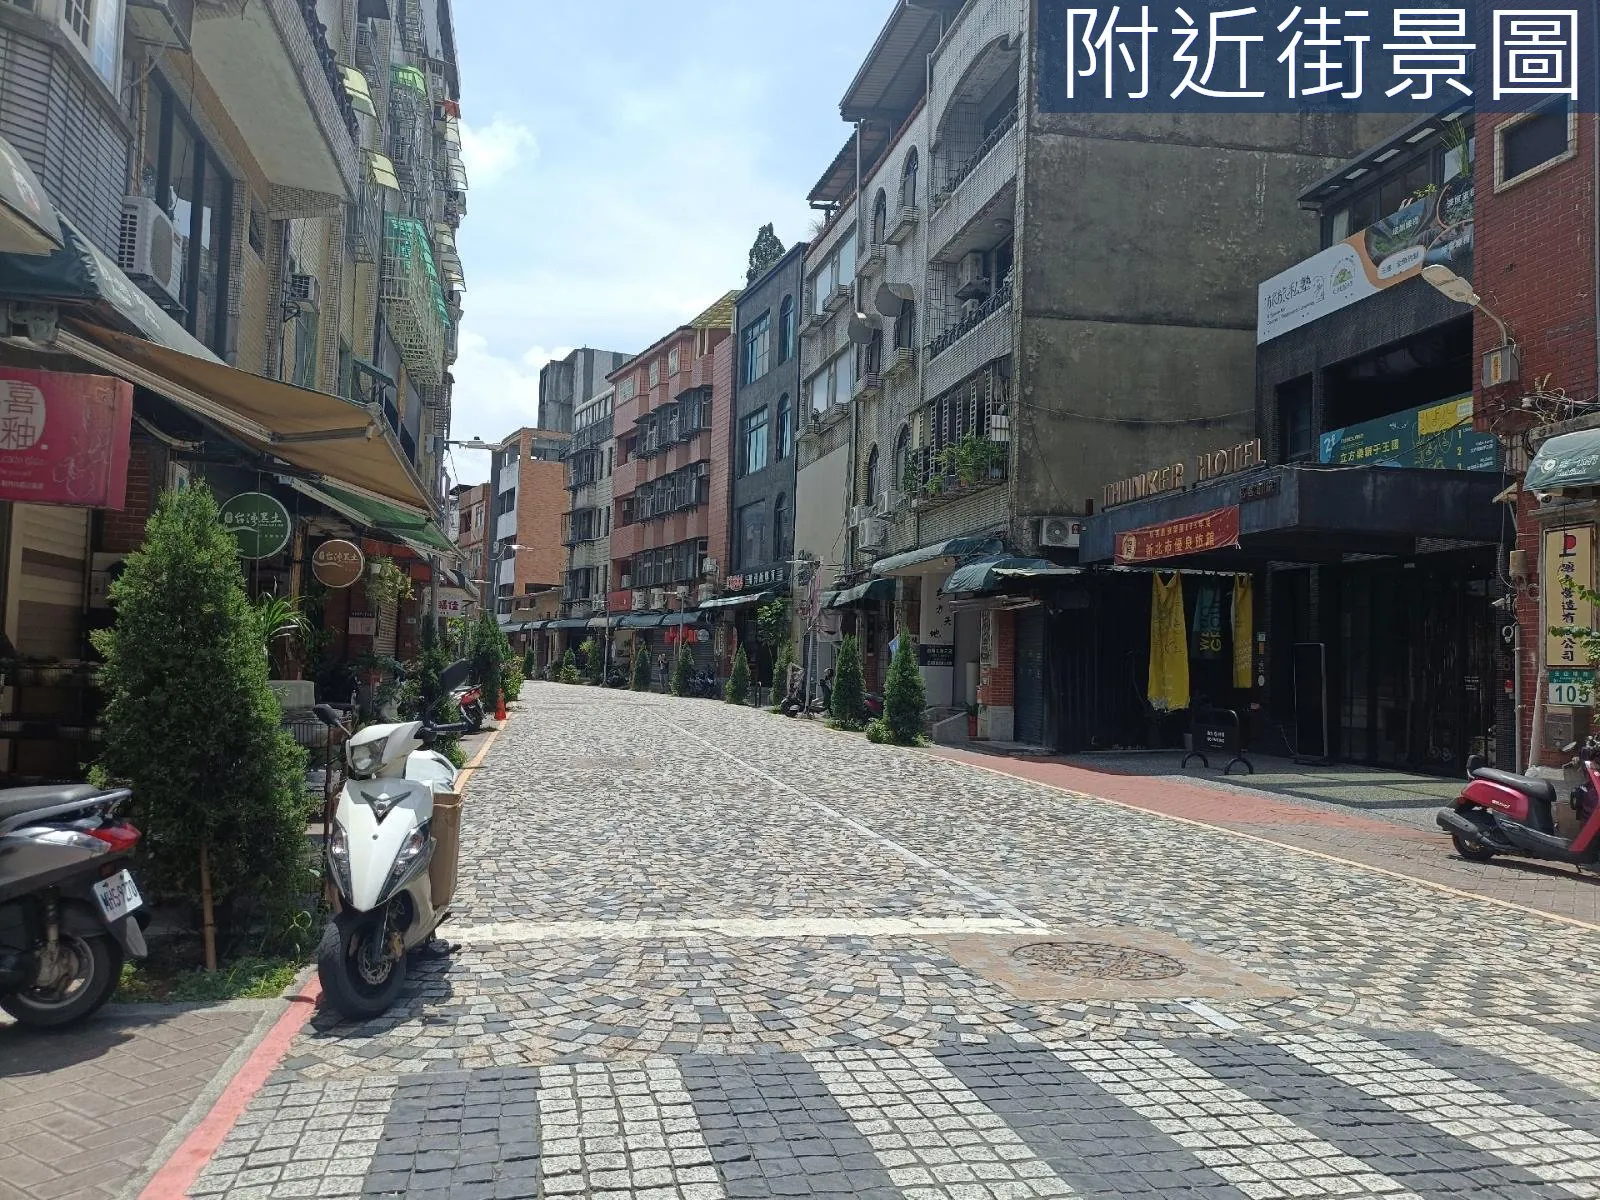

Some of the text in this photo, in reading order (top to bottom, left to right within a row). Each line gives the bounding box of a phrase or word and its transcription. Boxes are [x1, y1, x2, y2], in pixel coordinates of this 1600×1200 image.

[0, 380, 40, 450] 喜釉
[1102, 437, 1267, 506] THINKER HOTEL
[1145, 532, 1216, 557] 新北市優良旅館
[1559, 561, 1577, 663] 營造有公司
